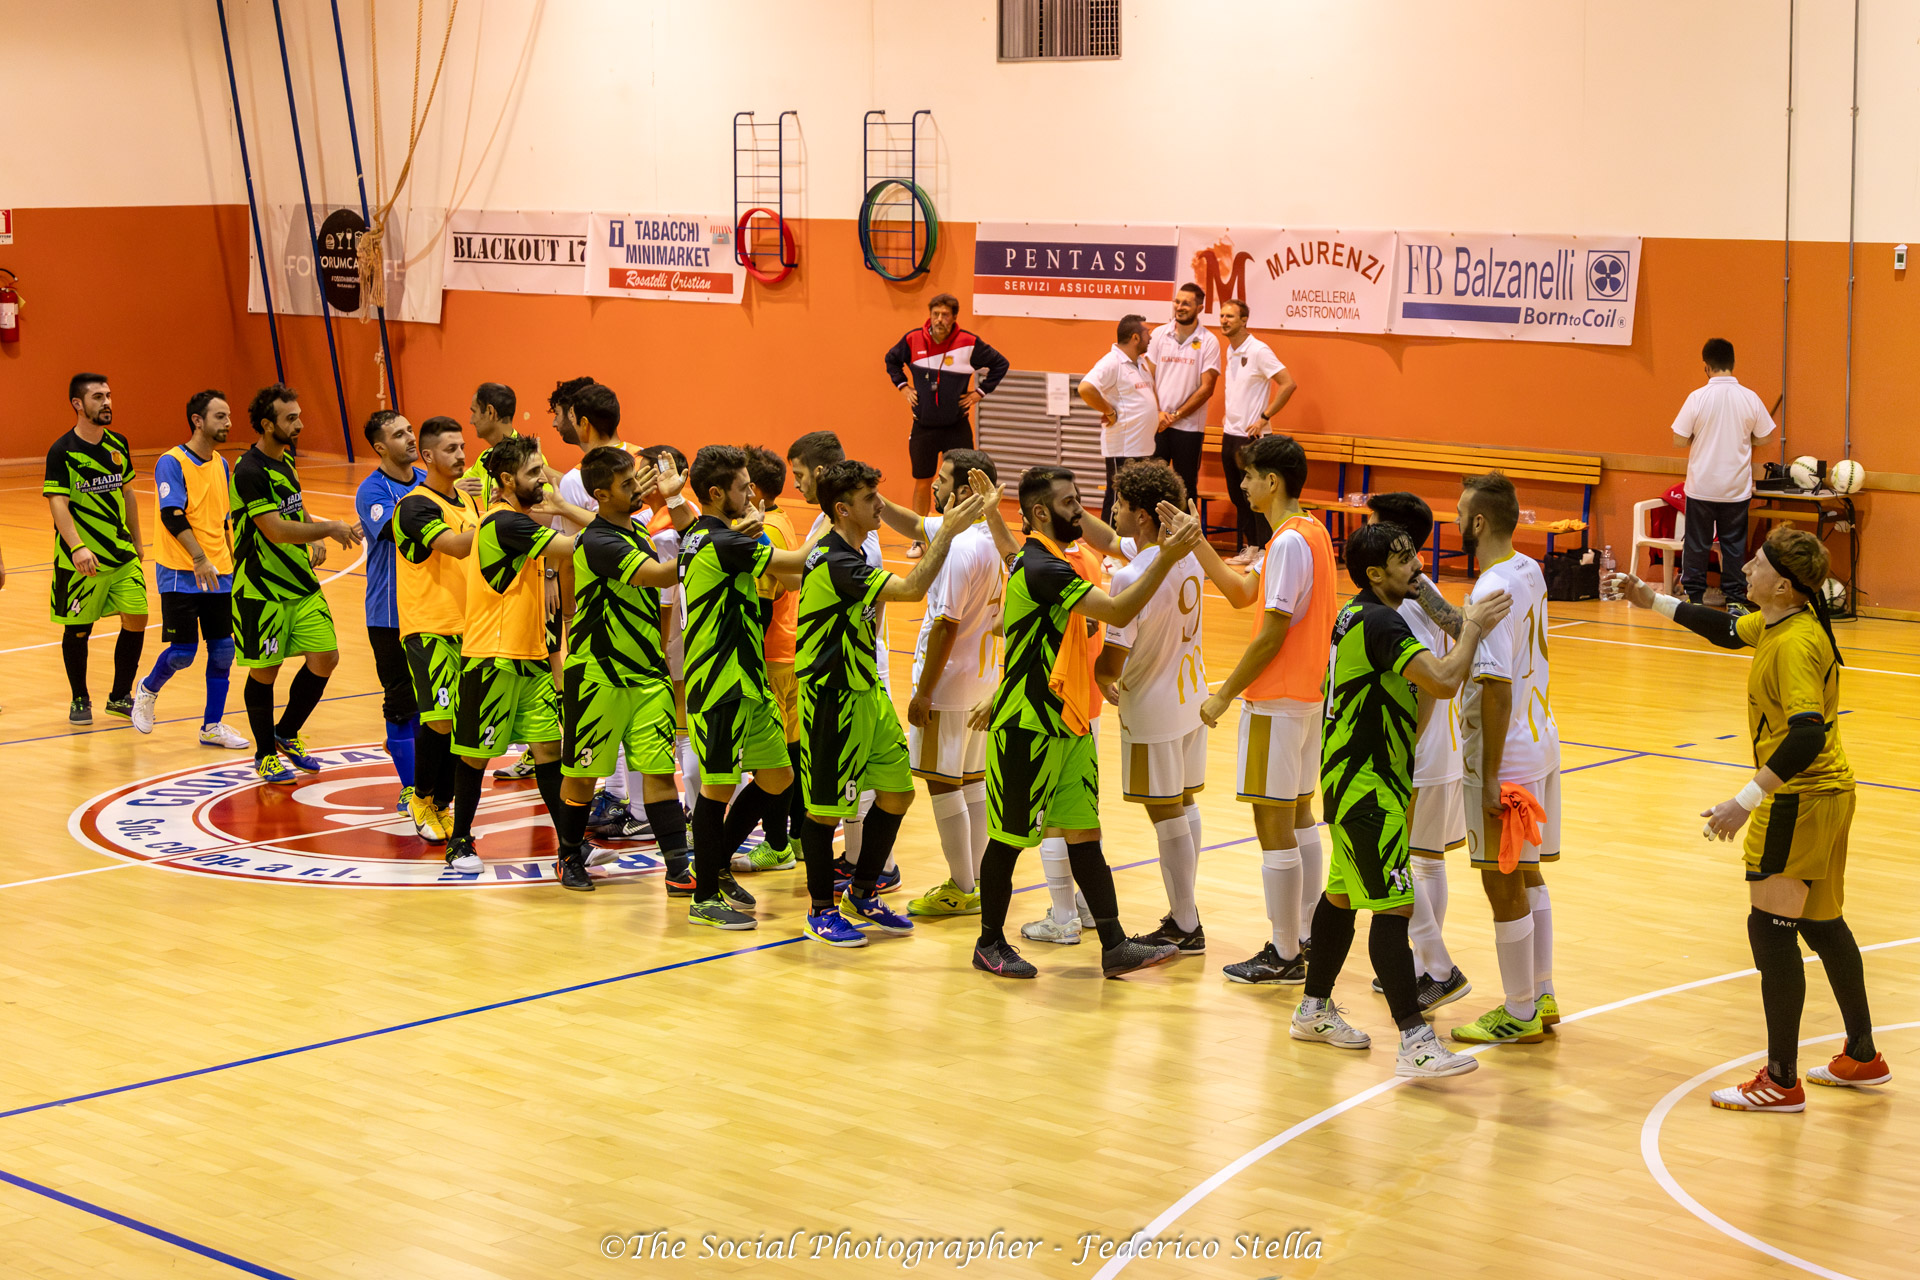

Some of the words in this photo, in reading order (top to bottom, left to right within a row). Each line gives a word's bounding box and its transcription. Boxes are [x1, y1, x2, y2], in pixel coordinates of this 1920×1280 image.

[634, 220, 700, 242] TABACCHI
[453, 236, 560, 262] BLACKOUT
[625, 244, 711, 267] MINIMARKET
[1005, 248, 1148, 273] PENTASS
[1266, 241, 1386, 285] MAURENZI
[625, 270, 668, 288] Rosatelli
[670, 271, 712, 291] Cristian
[1454, 246, 1576, 301] Balzanelli
[1004, 280, 1050, 292] SERVIZI
[1059, 282, 1146, 296] ASSICURATIVI
[1291, 289, 1357, 304] MACELLERIA
[1285, 305, 1361, 321] GASTRONOMIA
[70, 598, 82, 615] 4
[1178, 575, 1201, 643] 9
[263, 637, 279, 655] 14
[437, 686, 450, 707] 8
[483, 725, 496, 746] 2
[579, 747, 594, 768] 3
[845, 779, 858, 802] 6
[1772, 918, 1798, 928] BART
